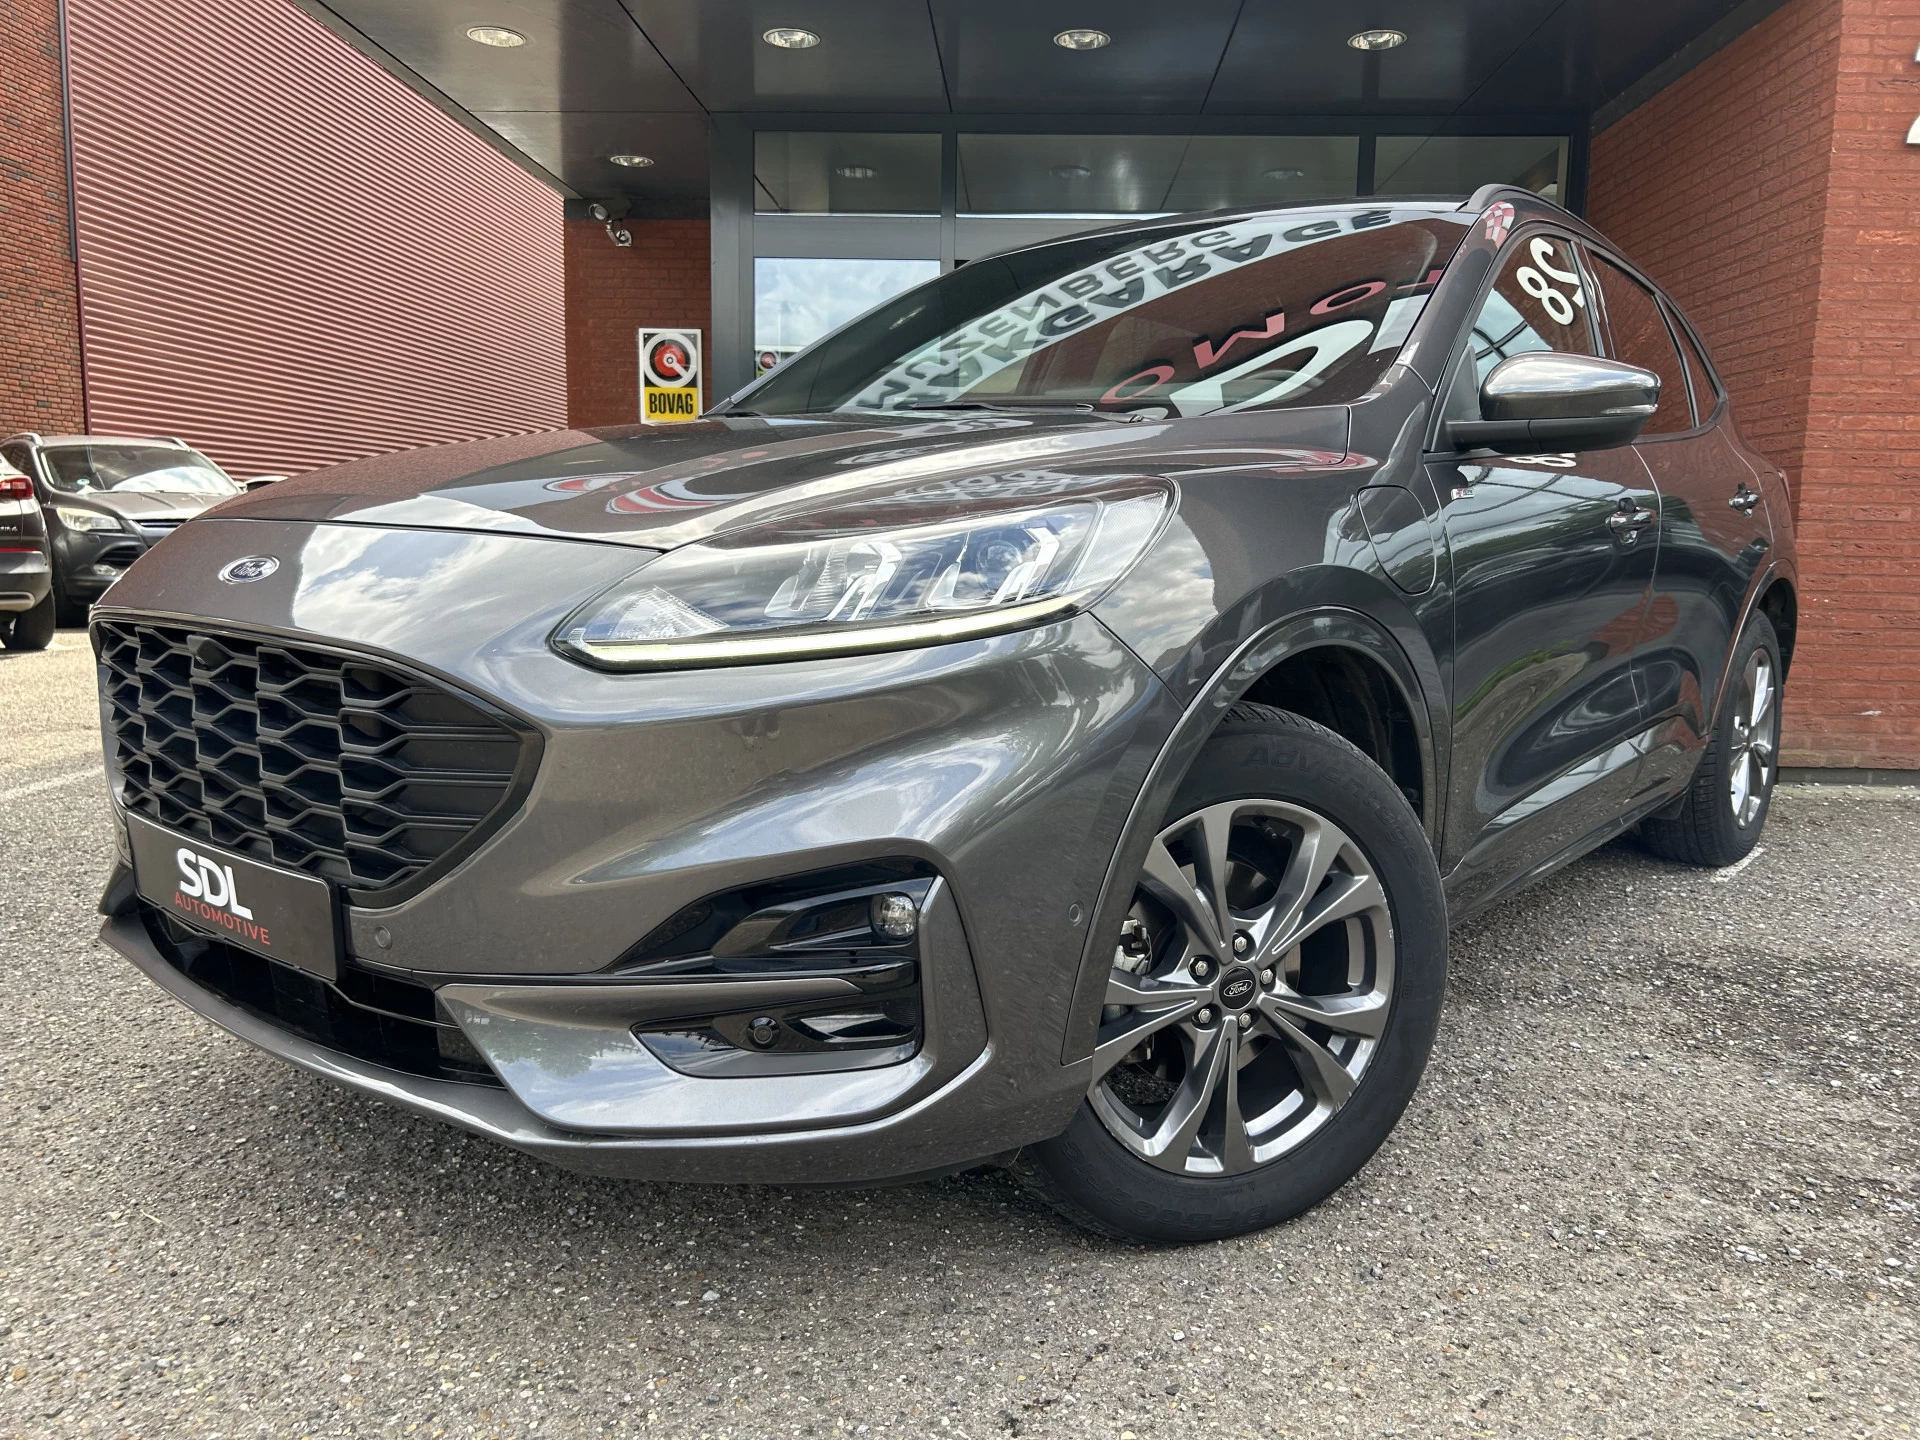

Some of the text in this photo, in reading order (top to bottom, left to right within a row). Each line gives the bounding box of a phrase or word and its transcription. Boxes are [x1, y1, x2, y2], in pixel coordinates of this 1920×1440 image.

[649, 393, 694, 415] BOVAG
[177, 847, 254, 921] SDL
[174, 891, 271, 946] AUTOMOTIVE
[1228, 982, 1248, 995] Ford
